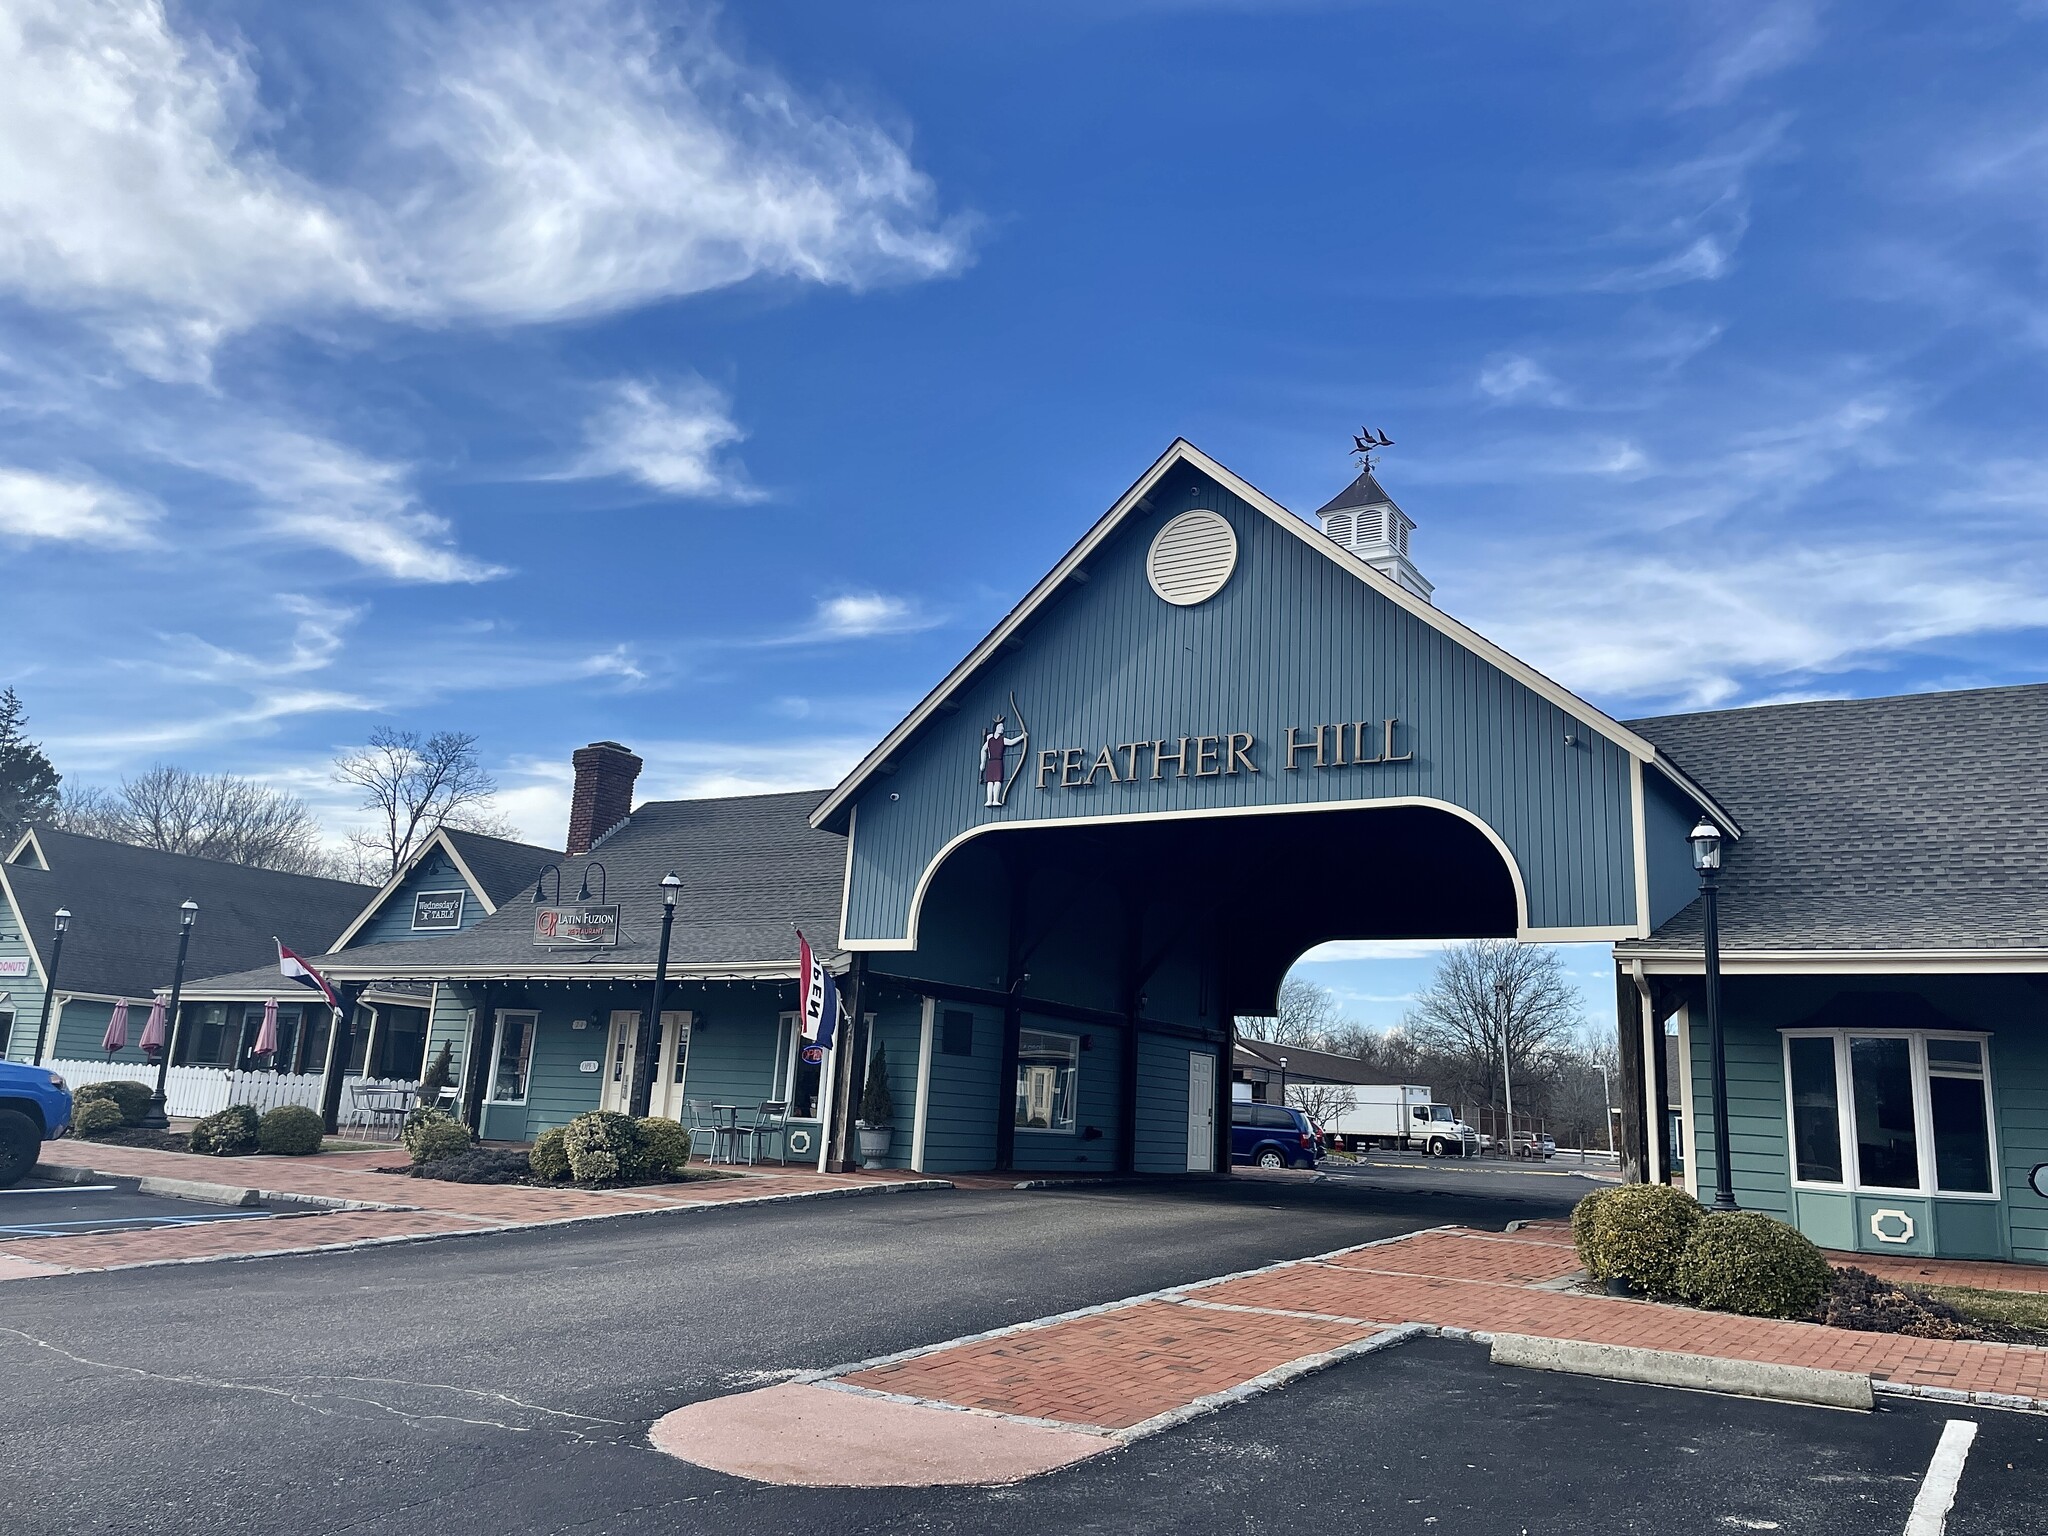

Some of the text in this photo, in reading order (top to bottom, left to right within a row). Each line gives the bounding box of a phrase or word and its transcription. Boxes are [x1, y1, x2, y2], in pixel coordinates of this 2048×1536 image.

[1034, 717, 1414, 790] FEATHER HILL
[418, 900, 459, 910] Wednesday's
[431, 910, 454, 919] TABLE
[558, 912, 614, 924] LATIN FUZION
[567, 927, 604, 936] RESTAURANT
